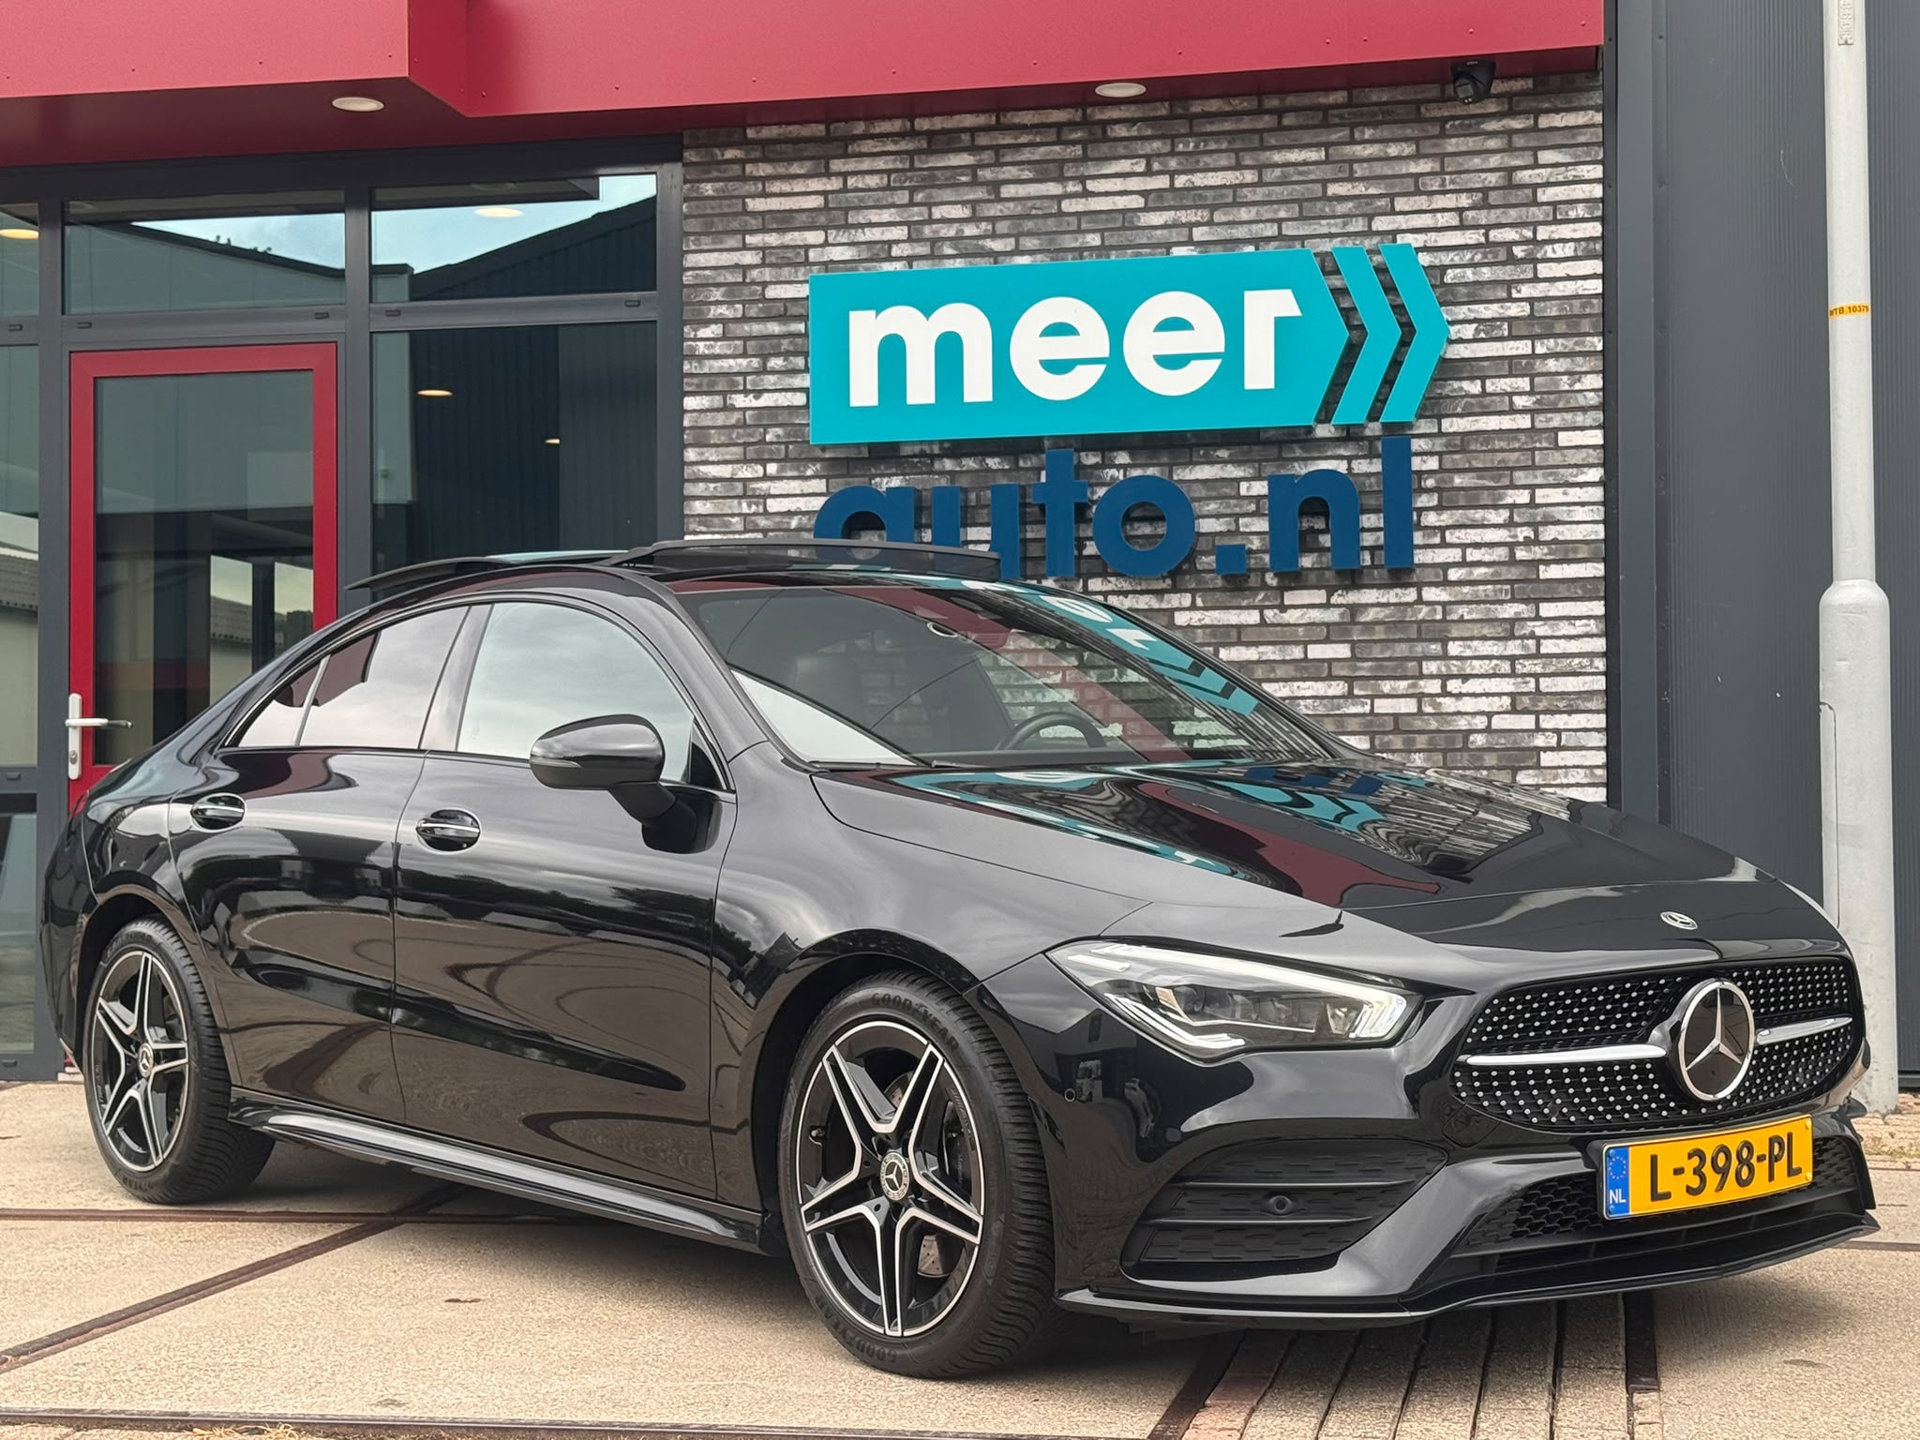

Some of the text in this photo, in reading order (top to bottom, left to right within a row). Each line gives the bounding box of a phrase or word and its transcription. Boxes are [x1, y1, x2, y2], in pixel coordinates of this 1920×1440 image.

[848, 288, 1303, 407] meer
[813, 436, 1415, 577] auto.nl
[1609, 1131, 1803, 1204] NL L-398-PL
